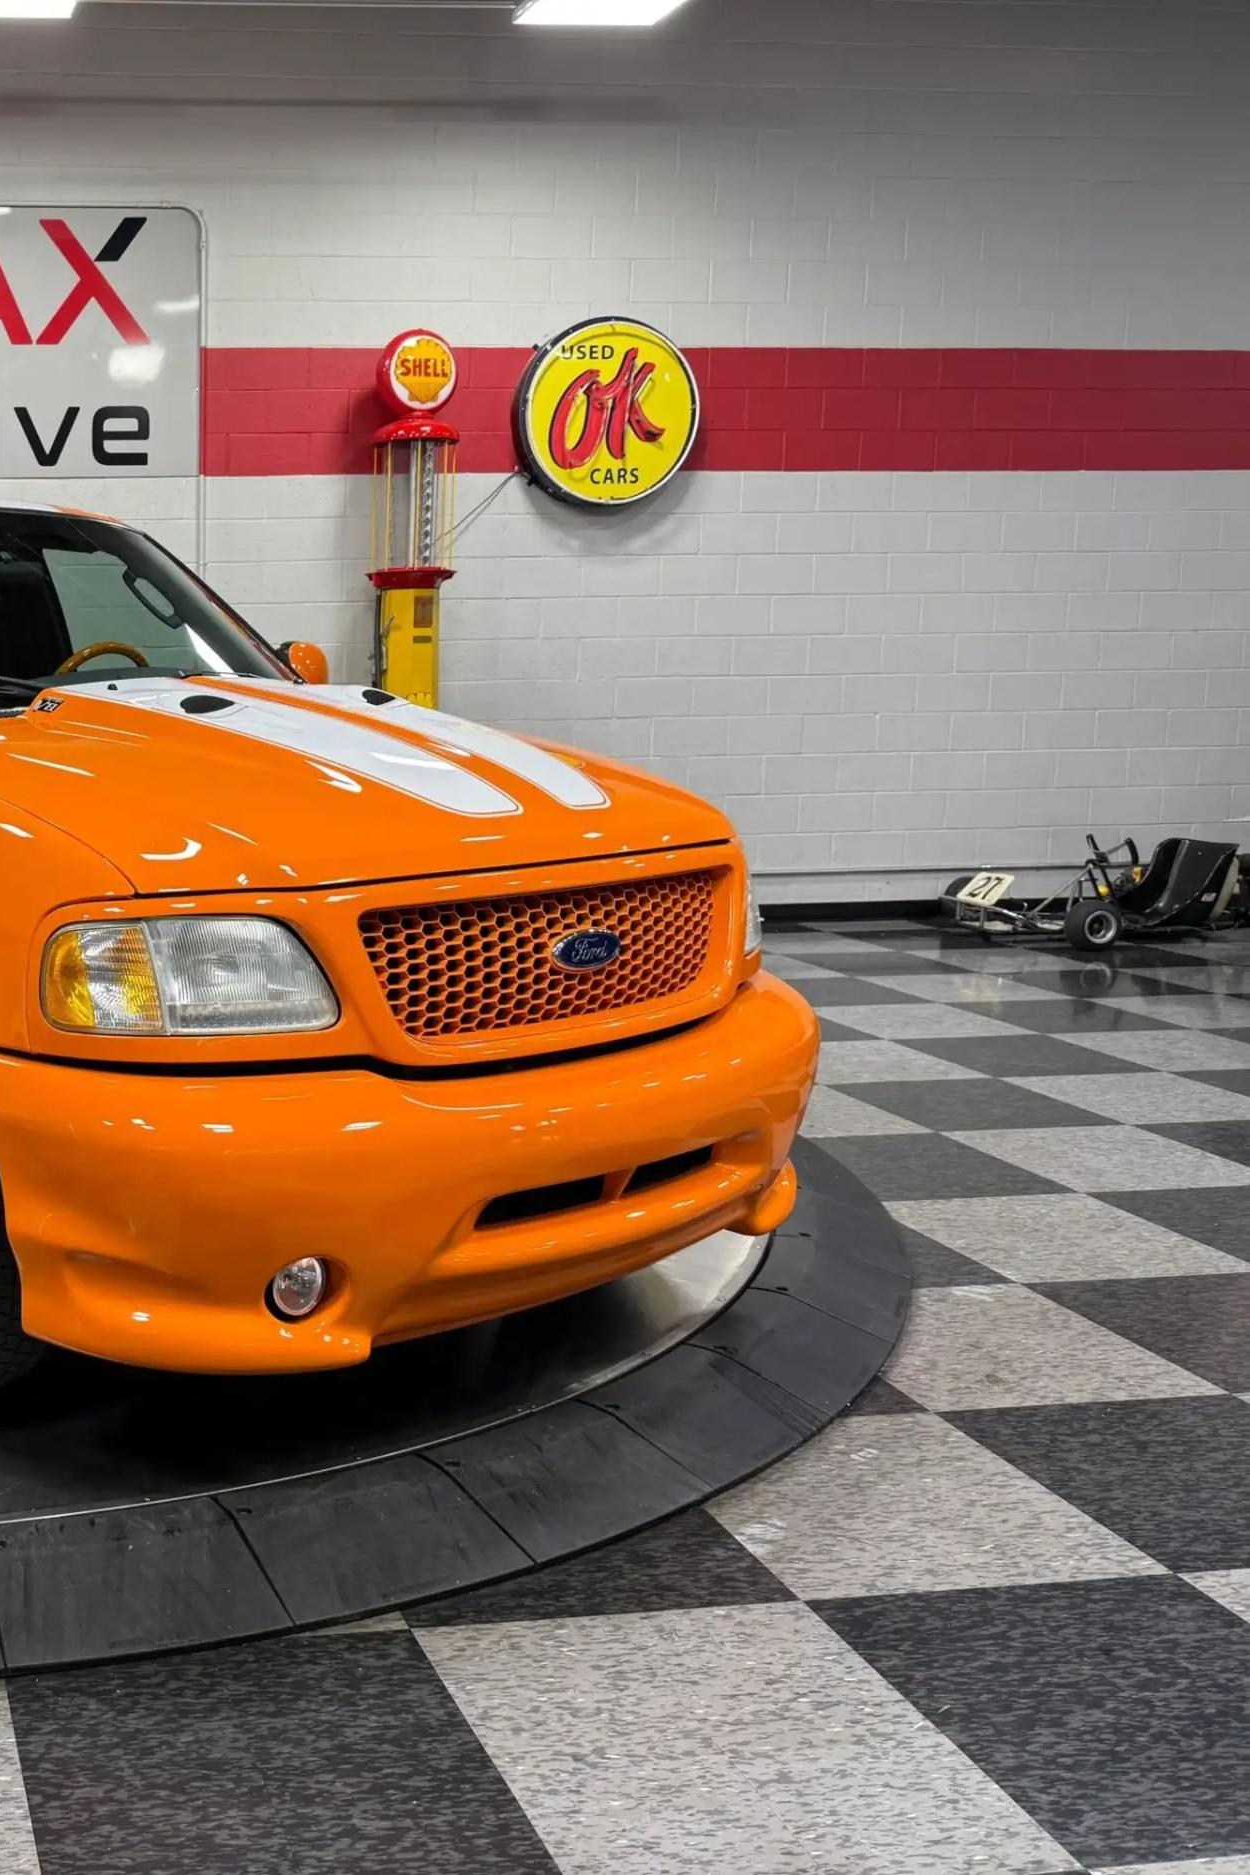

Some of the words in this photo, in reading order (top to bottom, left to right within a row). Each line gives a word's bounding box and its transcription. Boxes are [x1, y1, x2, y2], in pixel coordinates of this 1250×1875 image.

[561, 345, 615, 360] USED
[399, 358, 449, 378] SHELL
[548, 347, 666, 469] OK
[590, 468, 639, 485] CARS
[966, 876, 1004, 900] 27
[571, 937, 607, 962] Ford
